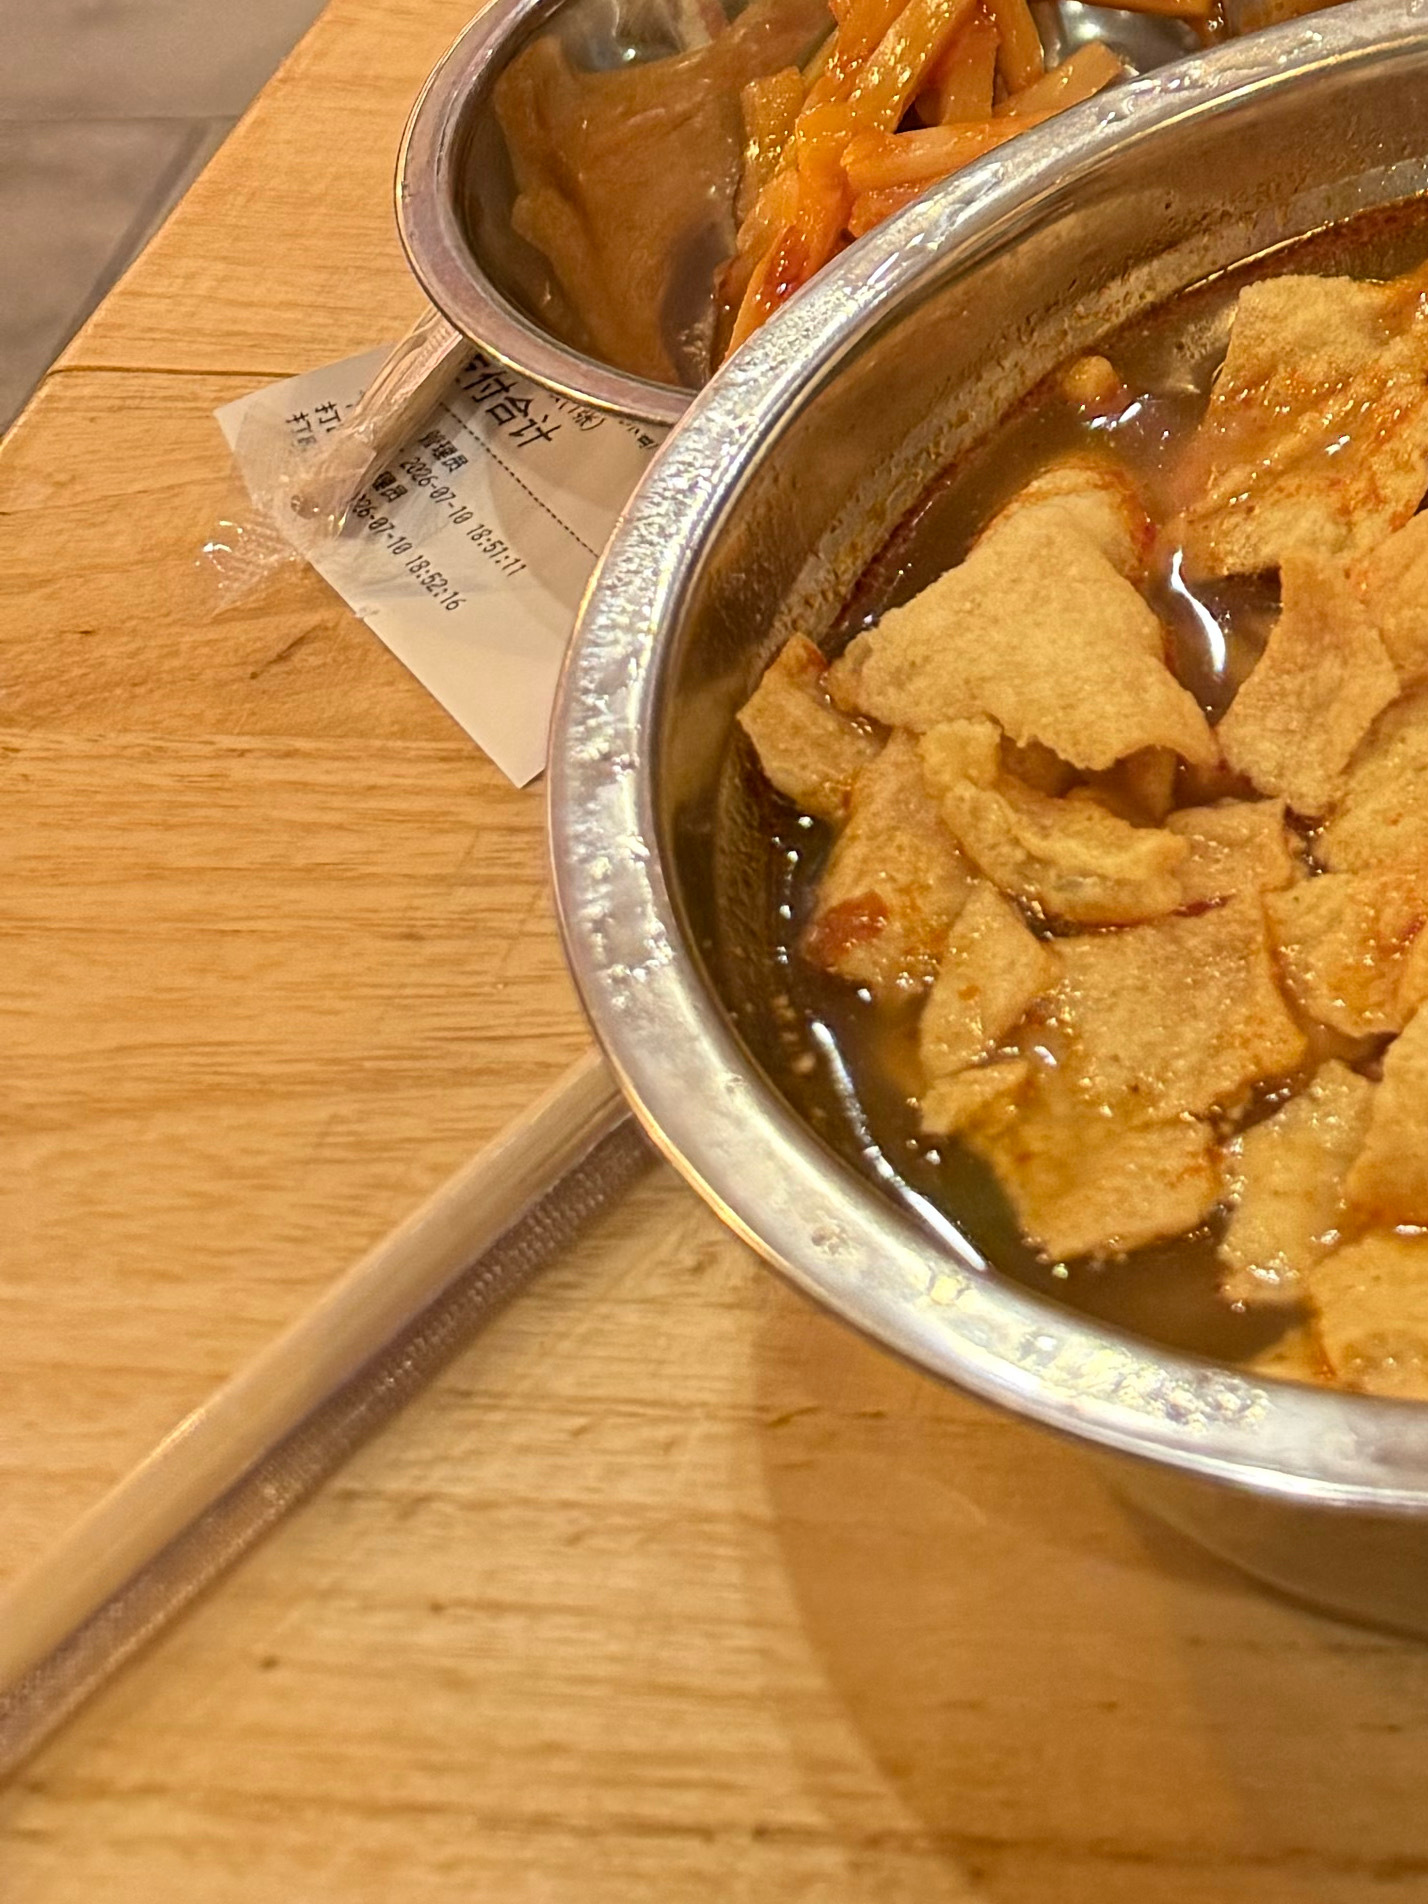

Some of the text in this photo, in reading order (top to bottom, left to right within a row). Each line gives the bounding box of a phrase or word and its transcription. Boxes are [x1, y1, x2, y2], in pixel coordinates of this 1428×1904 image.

[421, 429, 469, 473] 管理员
[399, 458, 527, 578] 2026-07-10 18:51:11
[405, 554, 465, 611] 18:52:16
